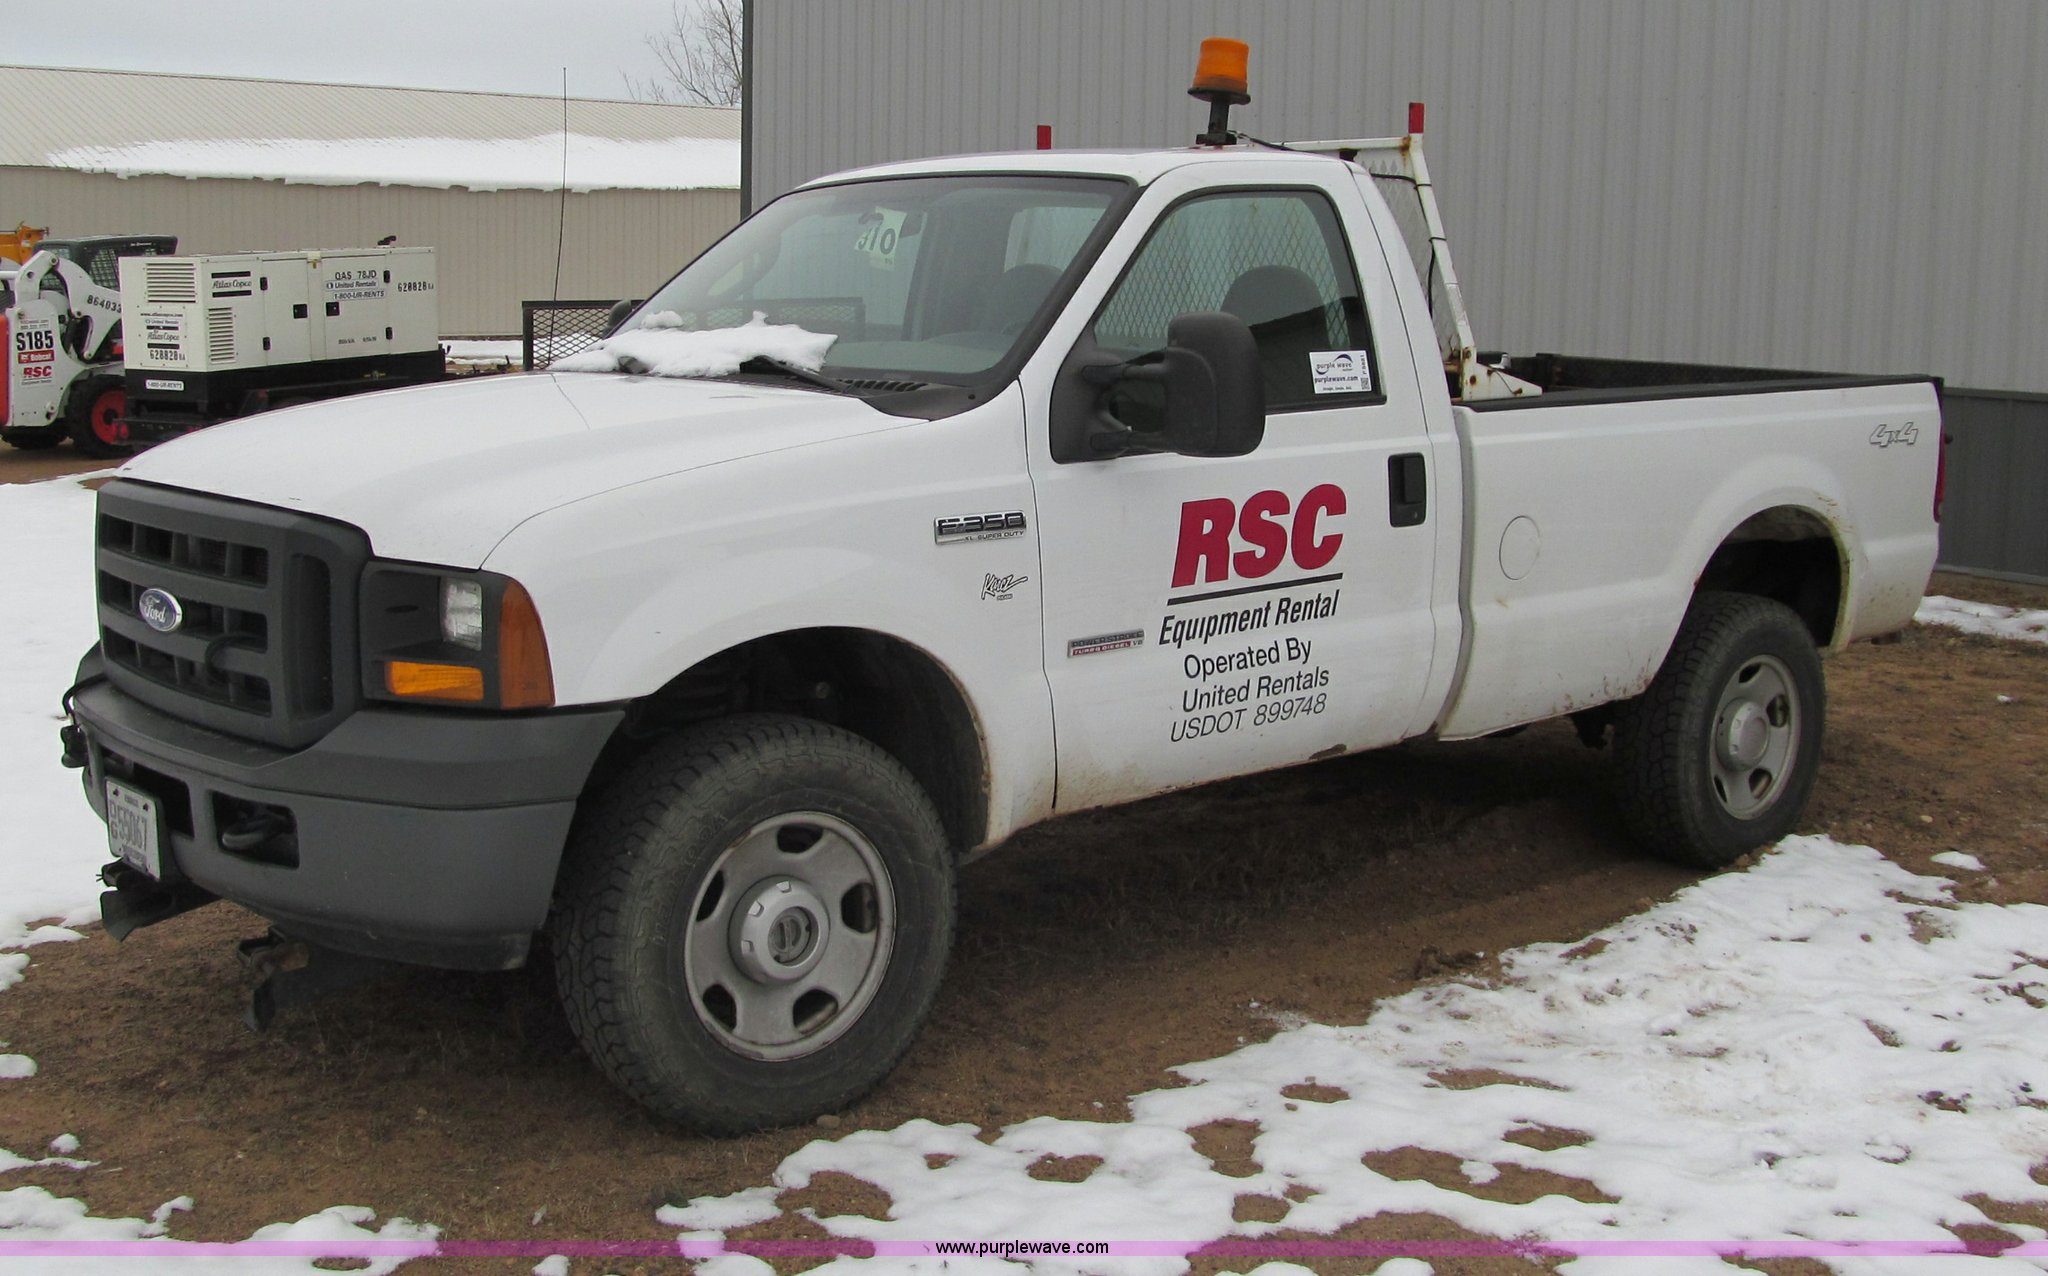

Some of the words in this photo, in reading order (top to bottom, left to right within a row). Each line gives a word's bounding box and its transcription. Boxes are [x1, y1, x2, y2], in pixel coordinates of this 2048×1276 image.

[334, 290, 384, 299] 1-800-UR-RENTS
[16, 330, 54, 351] S185
[23, 365, 52, 378] RSC
[1316, 362, 1336, 370] purple
[1314, 376, 1359, 384] purplewave.com
[1869, 421, 1919, 448] 4x4
[978, 532, 1002, 541] SUPER
[1003, 530, 1024, 538] DUTY
[1171, 484, 1348, 588] RSC
[144, 594, 166, 623] Ford
[1159, 601, 1271, 649] Equipment
[1275, 589, 1340, 626] Rental
[1184, 640, 1280, 682] Operated
[1285, 637, 1312, 664] By
[1183, 679, 1250, 712] United
[1256, 666, 1329, 698] Rentals
[1170, 708, 1247, 742] USDOT
[1253, 693, 1327, 726] 899748
